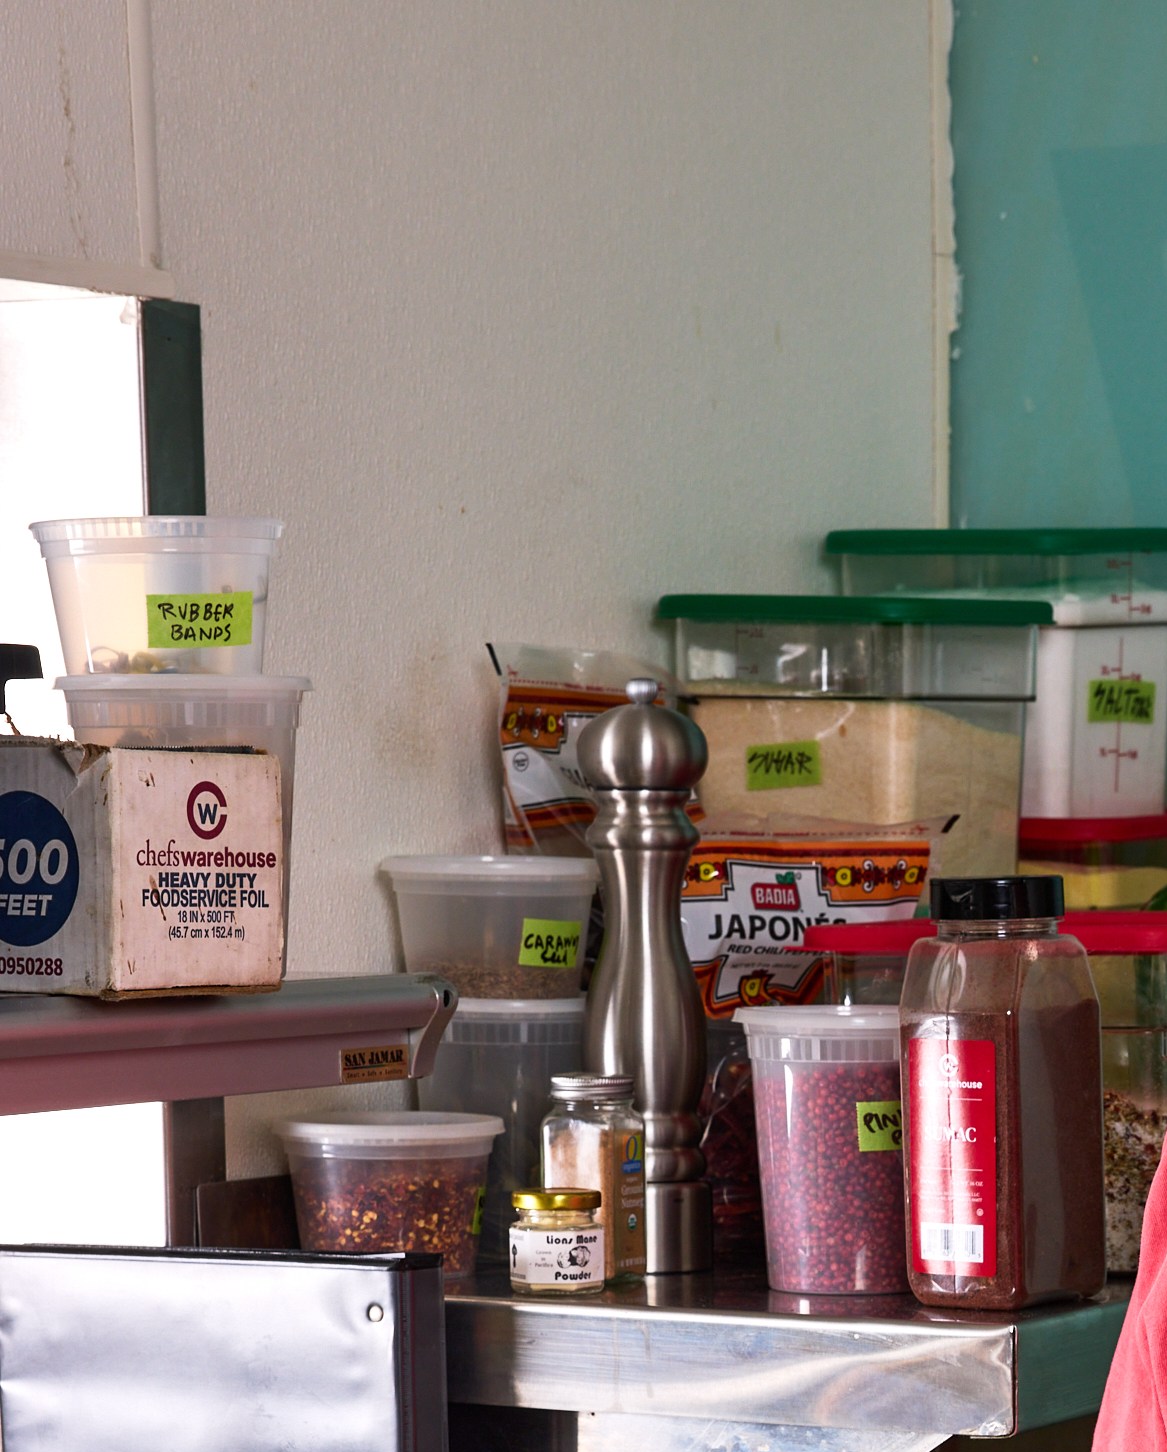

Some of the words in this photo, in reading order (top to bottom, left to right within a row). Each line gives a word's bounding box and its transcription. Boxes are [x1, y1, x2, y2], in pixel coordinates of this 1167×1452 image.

[158, 602, 234, 622] RUBBER
[171, 624, 231, 641] BANDS
[136, 839, 277, 868] chefswarehouse
[158, 872, 210, 888] HEAVY
[215, 873, 257, 889] DUTY
[142, 889, 236, 908] FOODSERVICE
[240, 890, 269, 908] FOIL
[755, 887, 796, 906] BADIA
[178, 910, 187, 923] 18
[189, 910, 198, 923] IN
[200, 913, 205, 923] x
[207, 910, 222, 923] 500
[224, 910, 235, 923] FT
[168, 925, 188, 941] (45.7
[190, 929, 202, 938] cm
[204, 929, 209, 938] x
[211, 926, 232, 939] 152.4
[234, 925, 245, 941] m)
[708, 913, 847, 941] JAPON
[727, 944, 752, 954] RED
[344, 1052, 365, 1067] SAN
[368, 1049, 404, 1064] JAMAR
[546, 1235, 573, 1245] Lions
[576, 1234, 597, 1244] Mane
[555, 1271, 592, 1281] Powder
